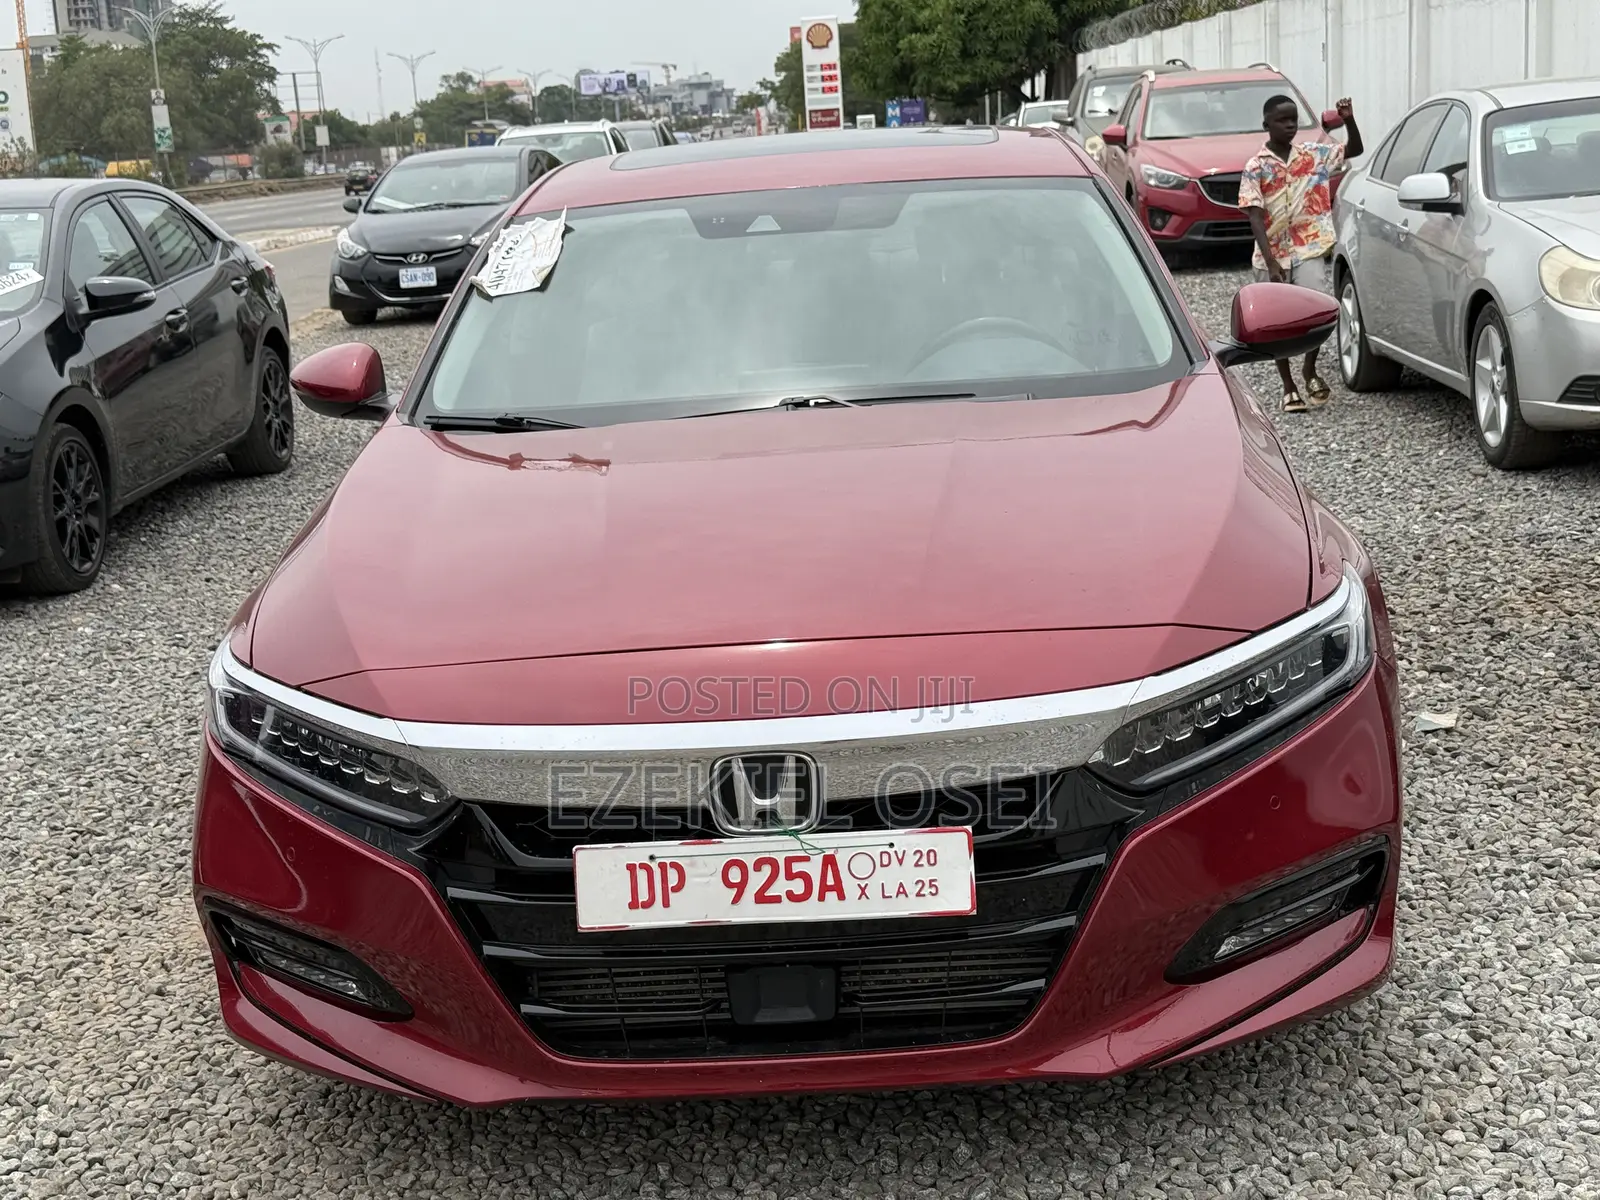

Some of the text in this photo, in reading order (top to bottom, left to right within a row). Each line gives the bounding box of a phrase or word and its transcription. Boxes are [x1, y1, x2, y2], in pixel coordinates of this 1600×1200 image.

[879, 848, 938, 868] DV 20
[625, 854, 846, 910] DP 925A
[856, 878, 940, 900] X LA 25
